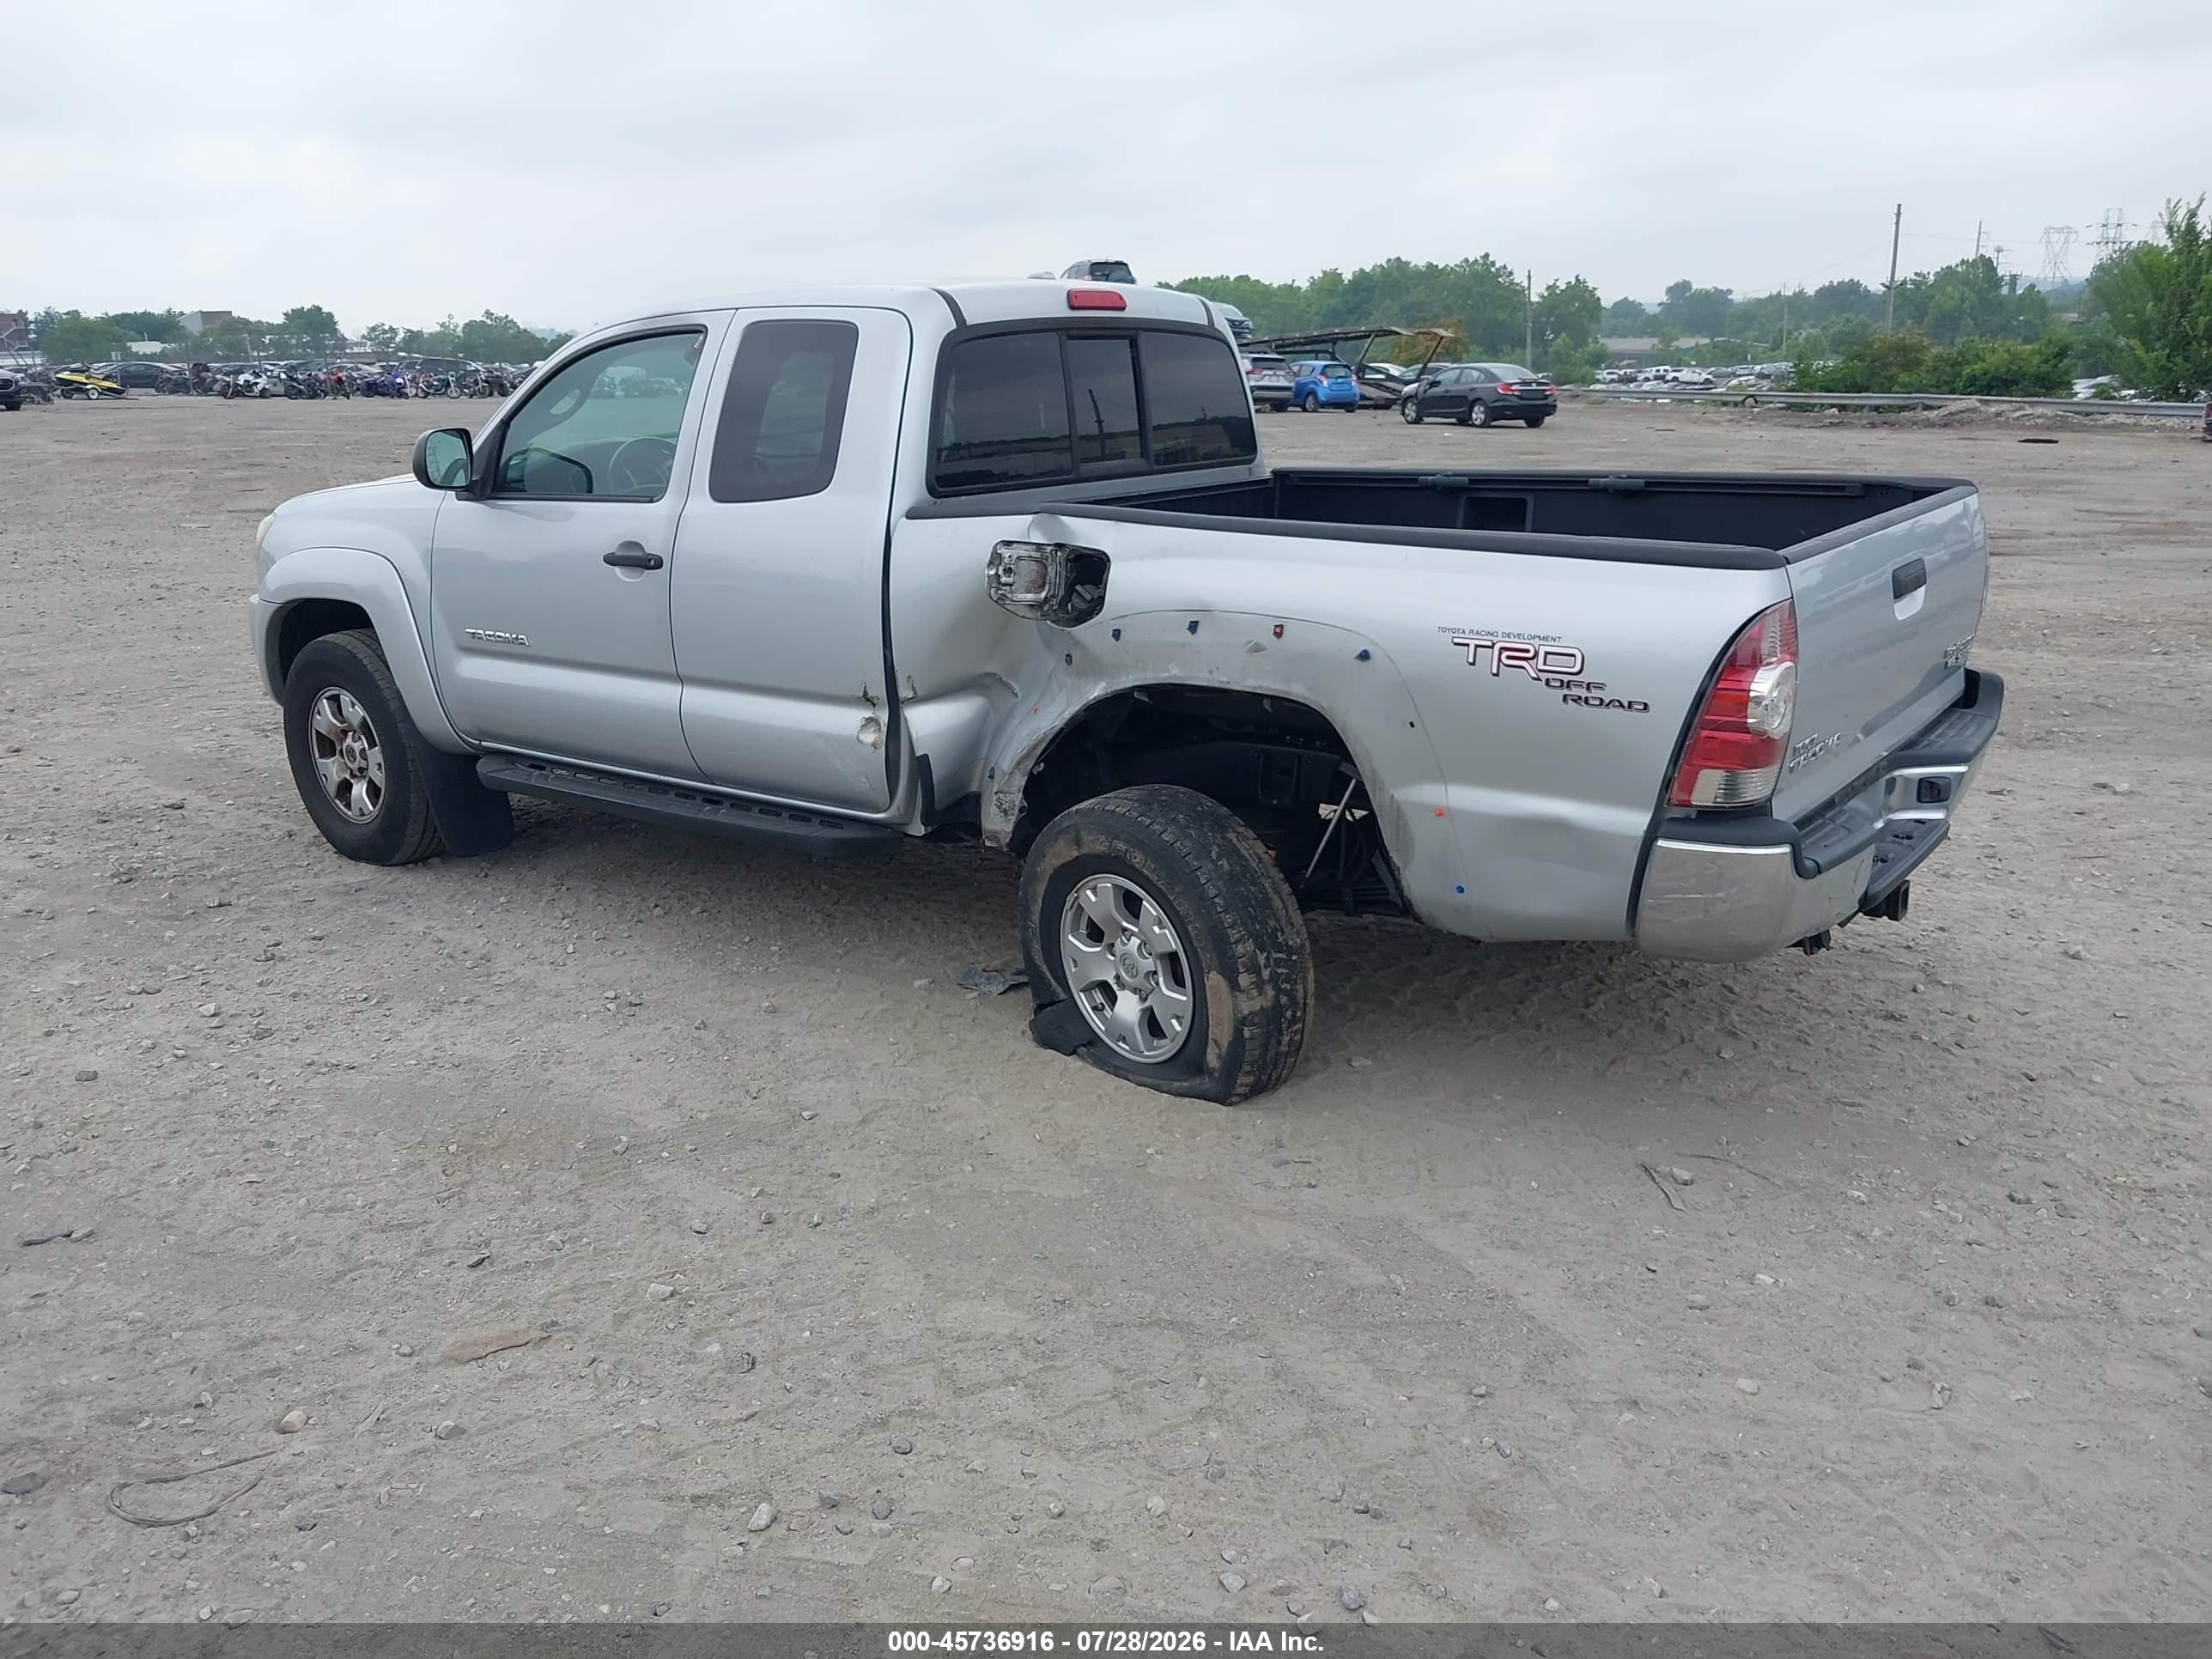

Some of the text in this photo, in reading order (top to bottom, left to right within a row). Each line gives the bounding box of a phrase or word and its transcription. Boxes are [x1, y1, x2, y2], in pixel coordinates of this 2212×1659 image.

[465, 628, 531, 647] TACOMA
[1437, 626, 1562, 643] TOYOTA RACING DEVELOPMENT
[1451, 636, 1585, 681] TRD
[1545, 678, 1607, 693] OFF
[1562, 694, 1650, 714] ROAD
